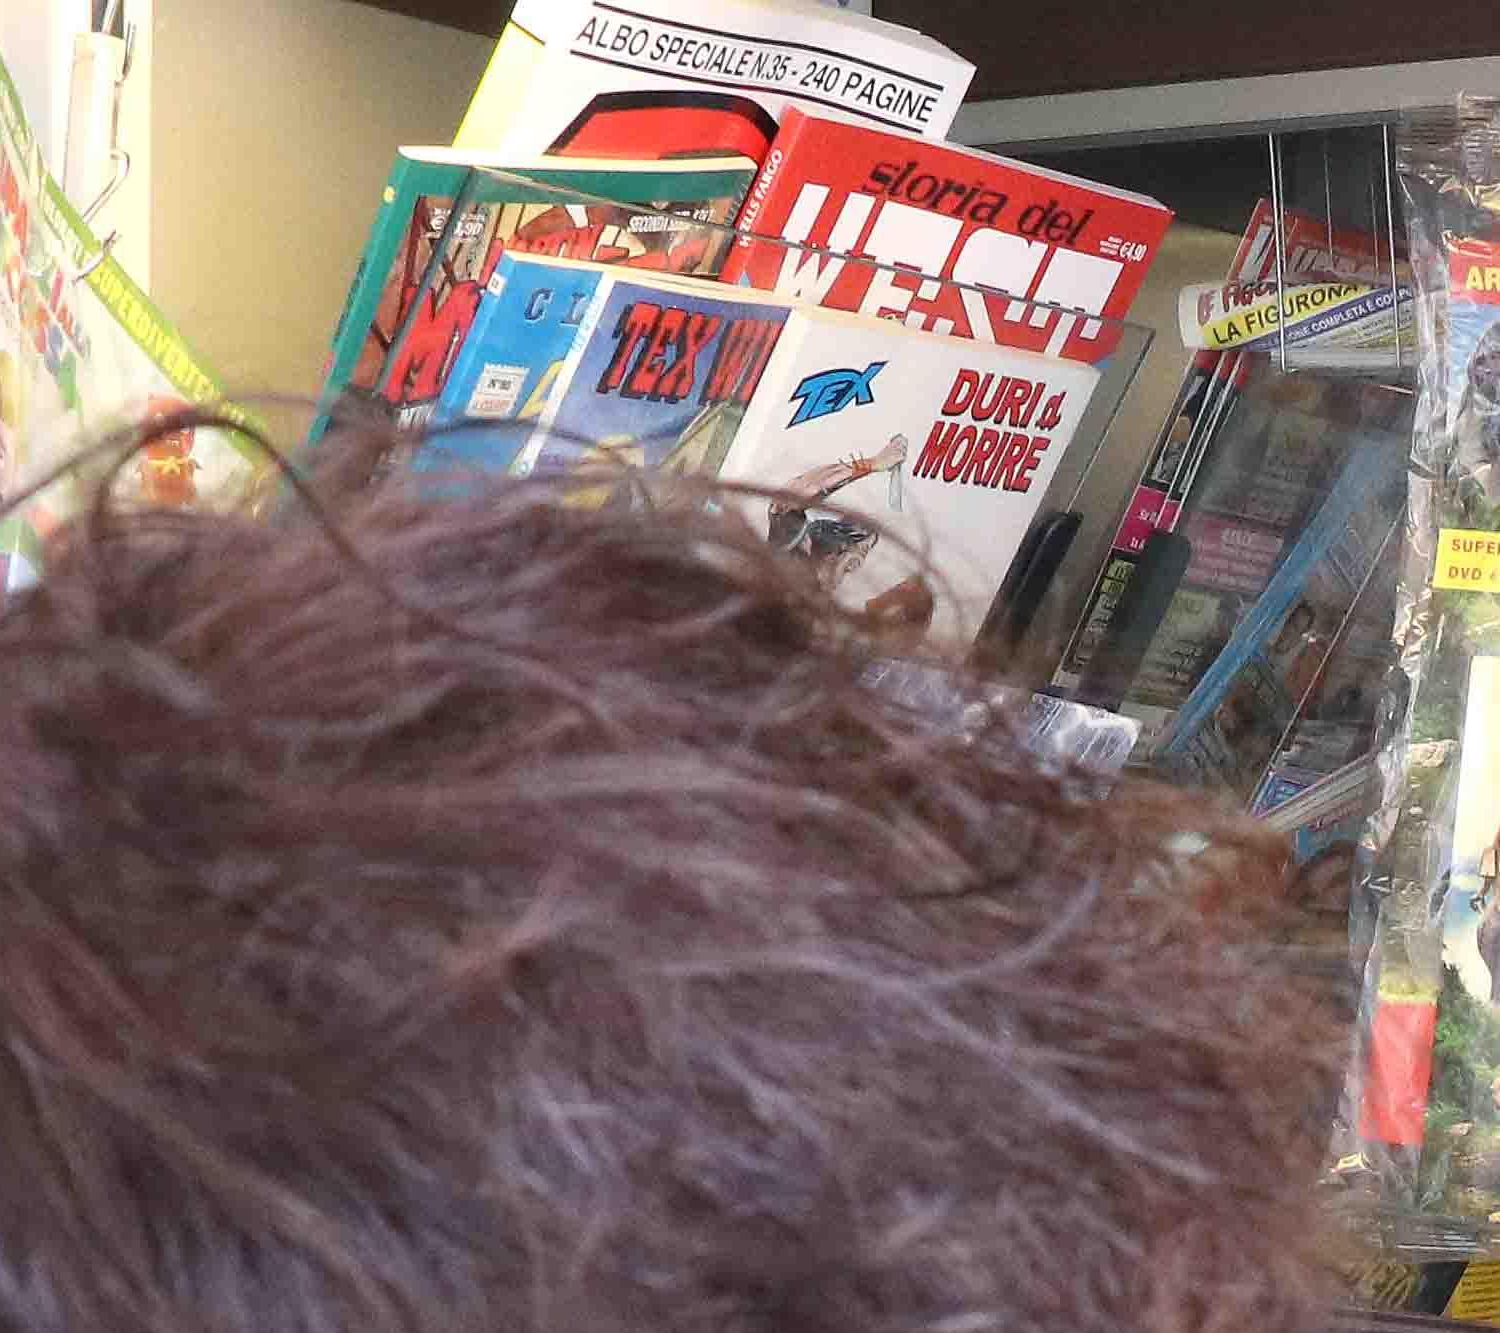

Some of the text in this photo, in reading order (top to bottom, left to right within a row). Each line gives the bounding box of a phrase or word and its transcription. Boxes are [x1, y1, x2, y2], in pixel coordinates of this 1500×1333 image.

[576, 16, 937, 124] ALBO SPECIALE 240 PAGINE
[861, 161, 1094, 244] storia del
[594, 302, 717, 403] TEX
[1213, 321, 1241, 344] LA
[788, 361, 889, 430] TEX
[940, 369, 1037, 430] DURI
[912, 421, 1052, 495] MORIRE
